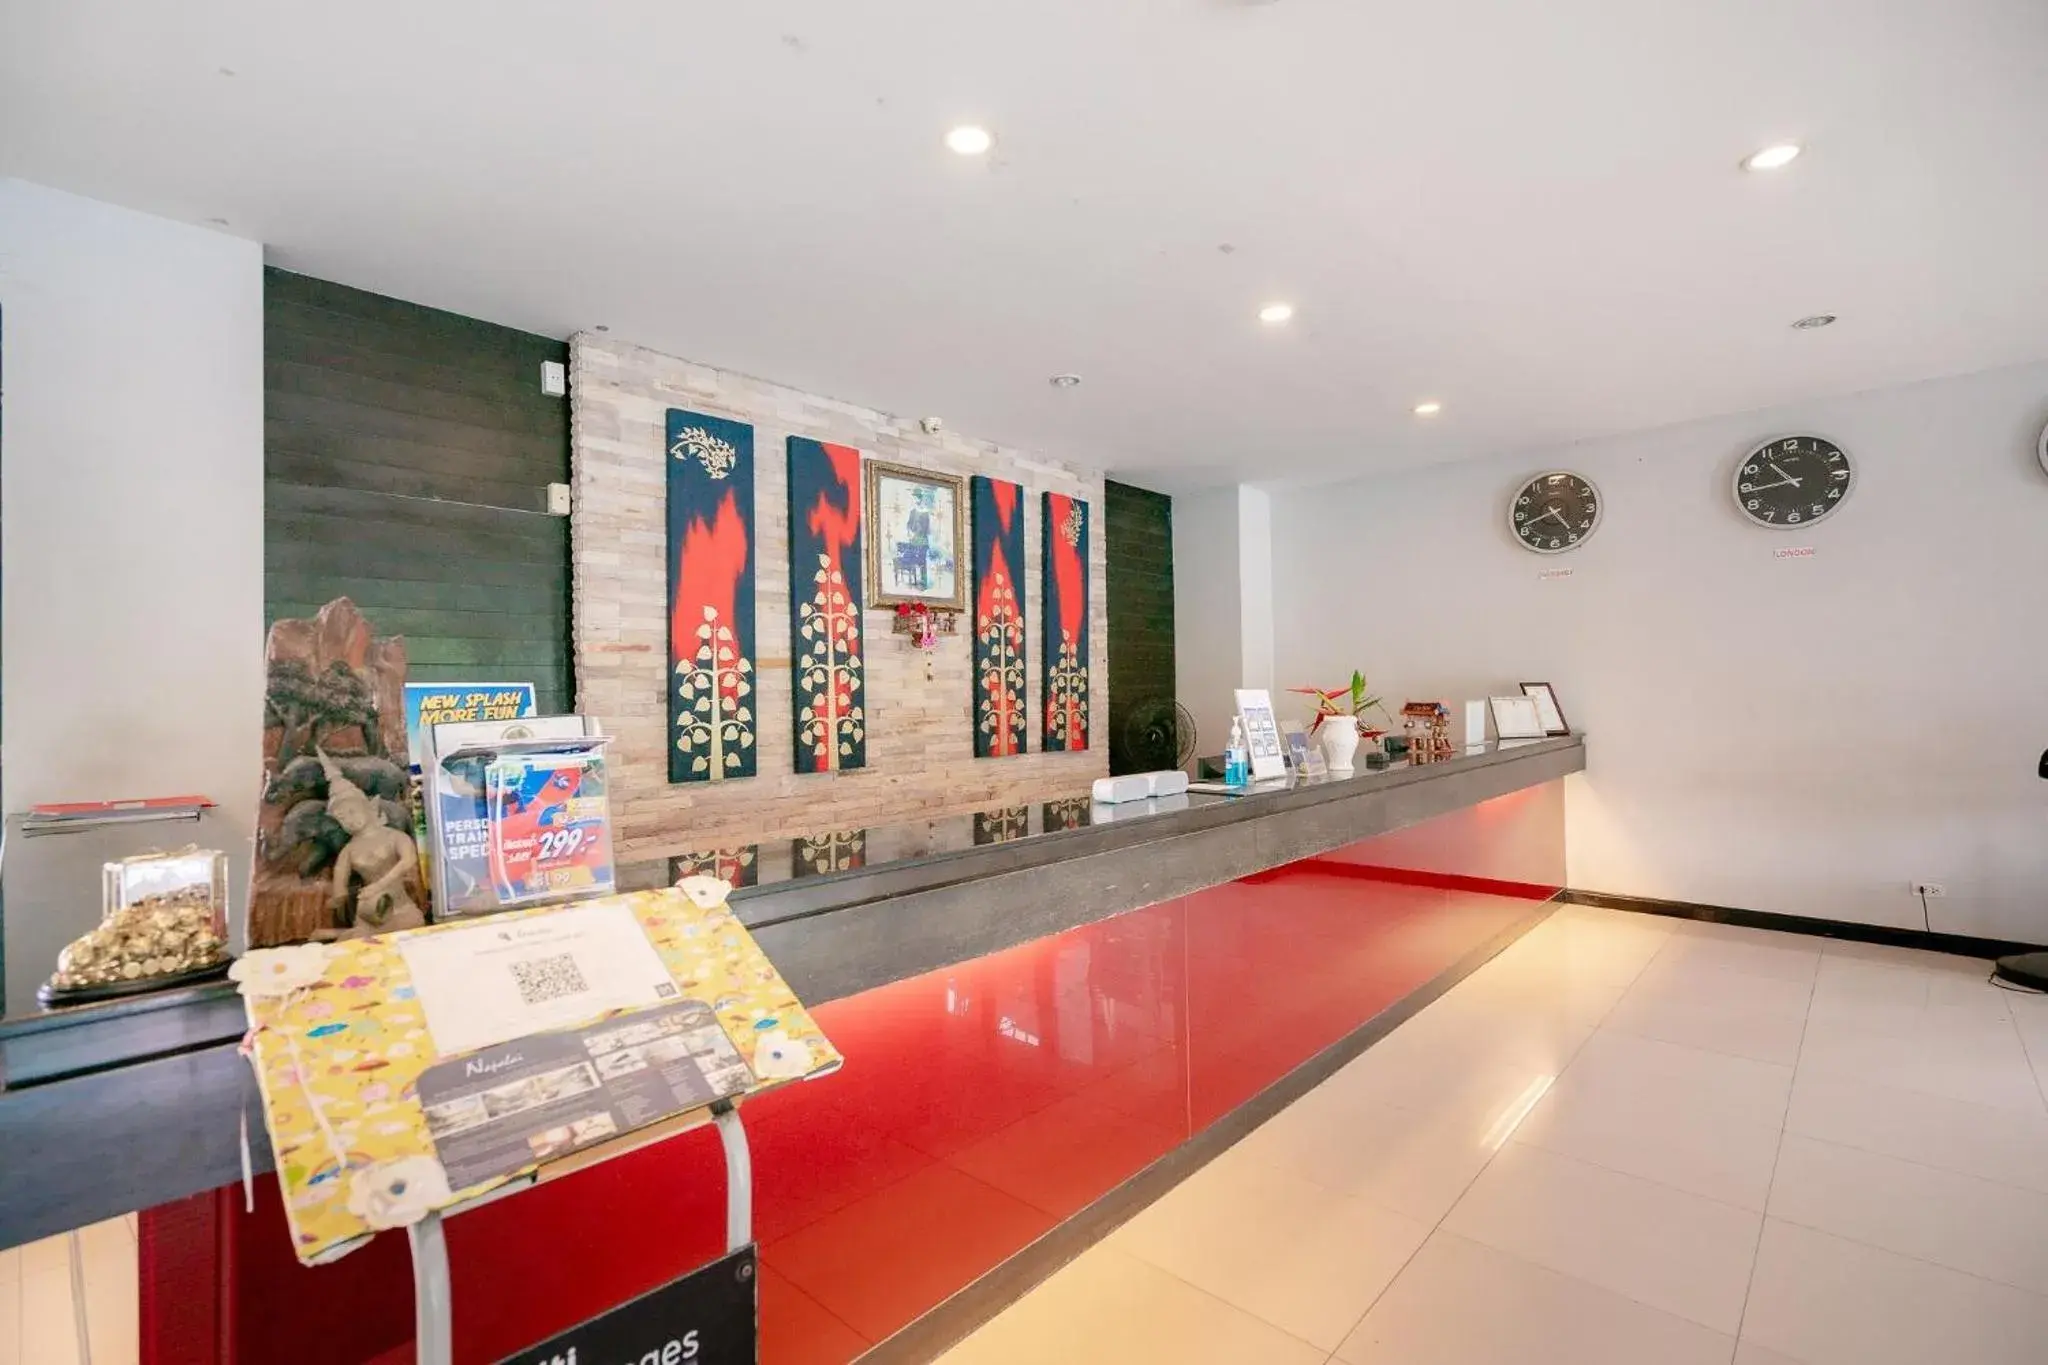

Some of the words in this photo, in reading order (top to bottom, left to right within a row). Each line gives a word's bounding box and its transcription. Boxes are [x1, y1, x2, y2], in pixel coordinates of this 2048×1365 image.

[1783, 439, 1798, 451] 12
[1812, 441, 1817, 451] 1
[1762, 448, 1775, 460] 11
[1828, 451, 1841, 462] 2
[1744, 464, 1758, 476] 10
[1532, 483, 1541, 493] 11
[1581, 487, 1591, 497] 2
[1827, 488, 1840, 499] 4
[1518, 496, 1530, 505] 10
[1747, 500, 1759, 510] 8
[1586, 503, 1596, 513] 3
[1812, 504, 1824, 515] 5
[1515, 512, 1525, 521] 9
[1763, 511, 1775, 522] 7
[1788, 512, 1801, 523] 6
[1580, 519, 1590, 528] 4
[1520, 526, 1530, 536] 8
[1532, 537, 1541, 547] 7
[1568, 533, 1578, 543] 5
[1550, 539, 1560, 548] 6
[420, 694, 461, 710] NEW
[465, 691, 522, 706] SPLASH
[420, 708, 478, 725] MORE
[484, 705, 519, 720] FUN
